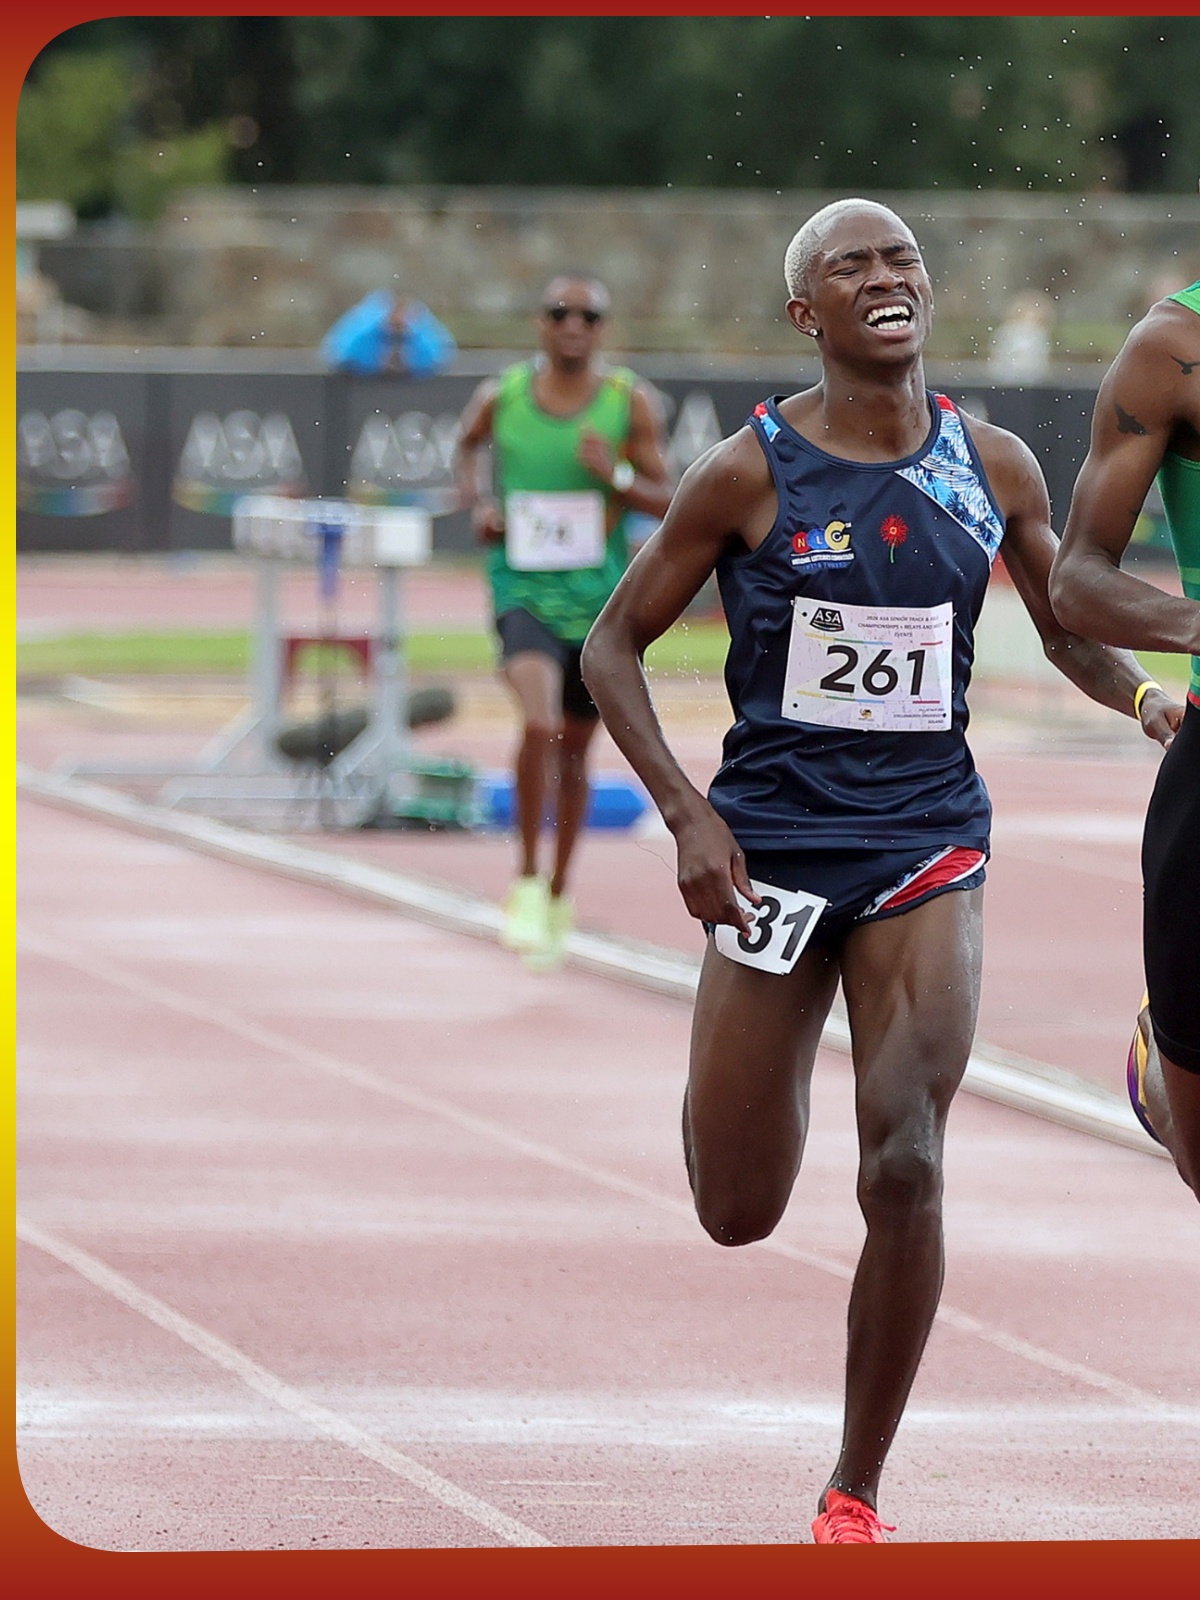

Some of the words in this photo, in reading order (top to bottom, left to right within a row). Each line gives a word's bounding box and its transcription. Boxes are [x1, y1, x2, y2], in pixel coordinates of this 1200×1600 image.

[179, 408, 305, 480] ASA
[815, 610, 841, 624] ASA
[820, 645, 926, 696] 261
[737, 896, 815, 961] 31
